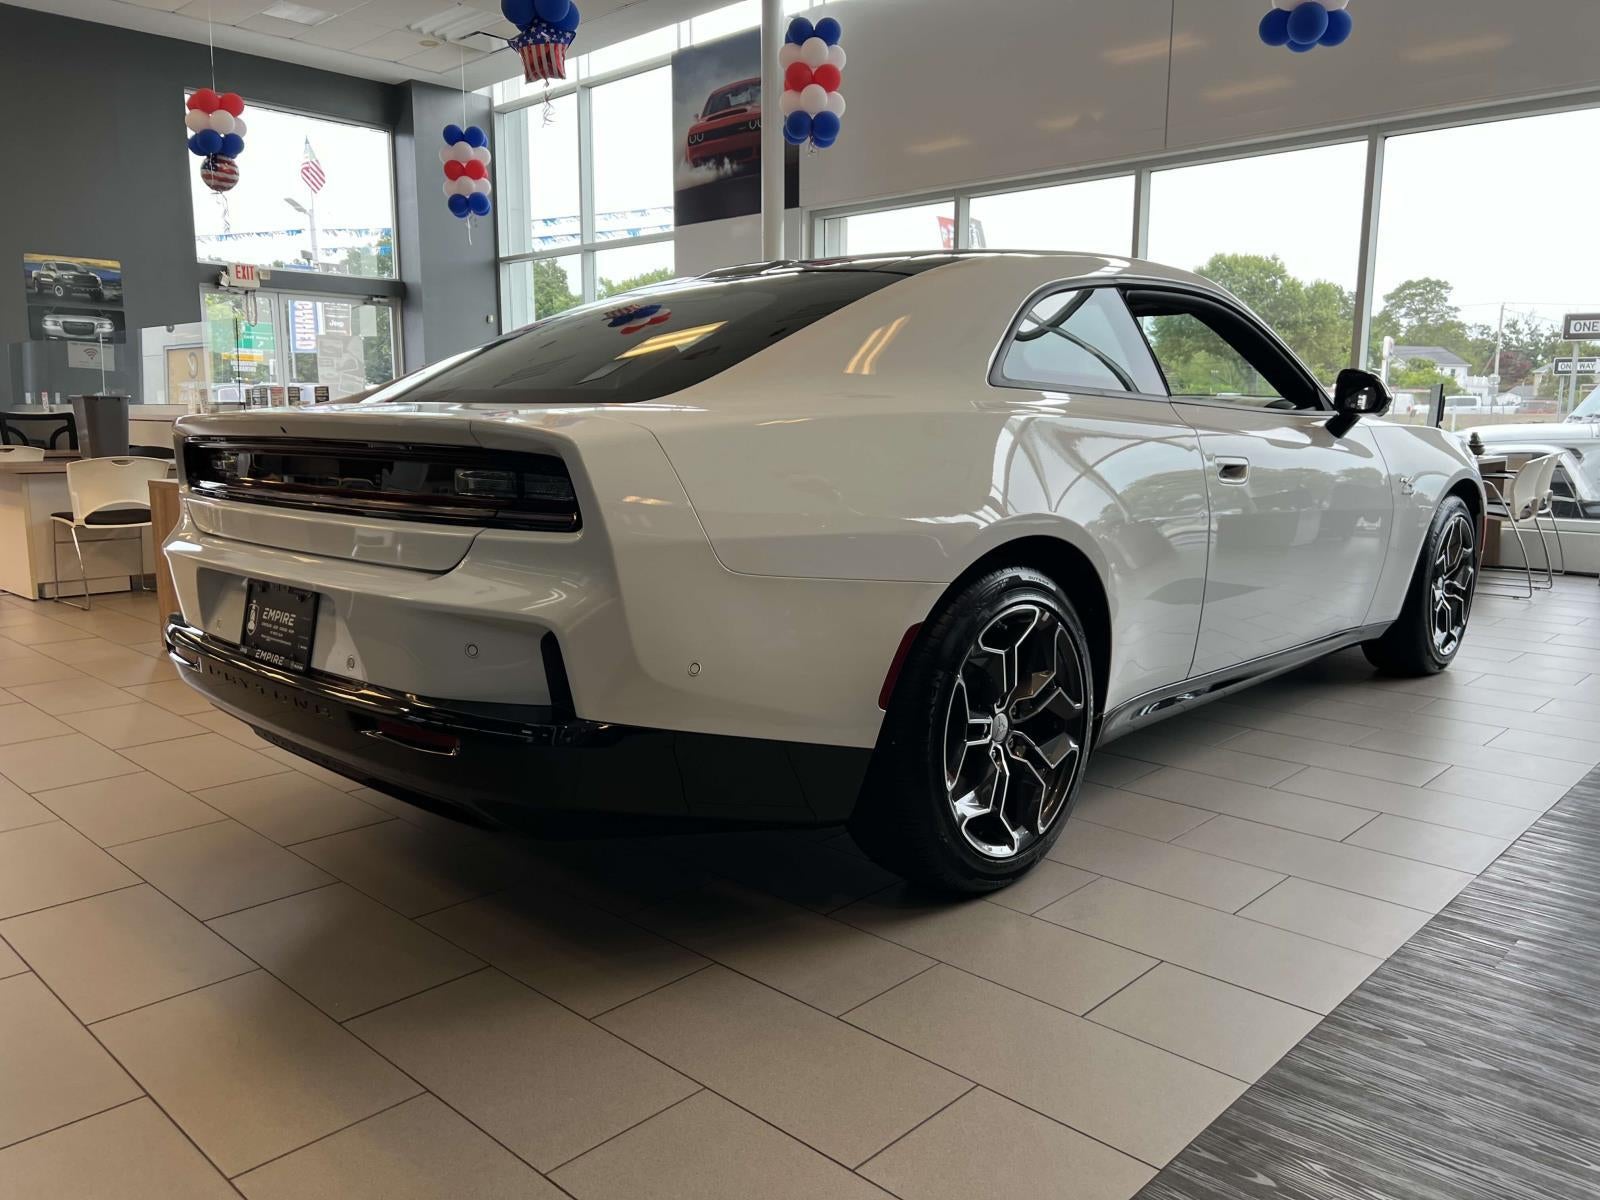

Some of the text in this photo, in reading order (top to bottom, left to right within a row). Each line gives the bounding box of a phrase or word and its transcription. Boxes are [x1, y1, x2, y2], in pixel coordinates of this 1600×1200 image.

[235, 265, 254, 281] EXIT
[329, 320, 344, 328] Jeep
[1573, 321, 1600, 332] ONE
[263, 607, 296, 626] EMPIRE
[255, 649, 285, 666] EMPIRE
